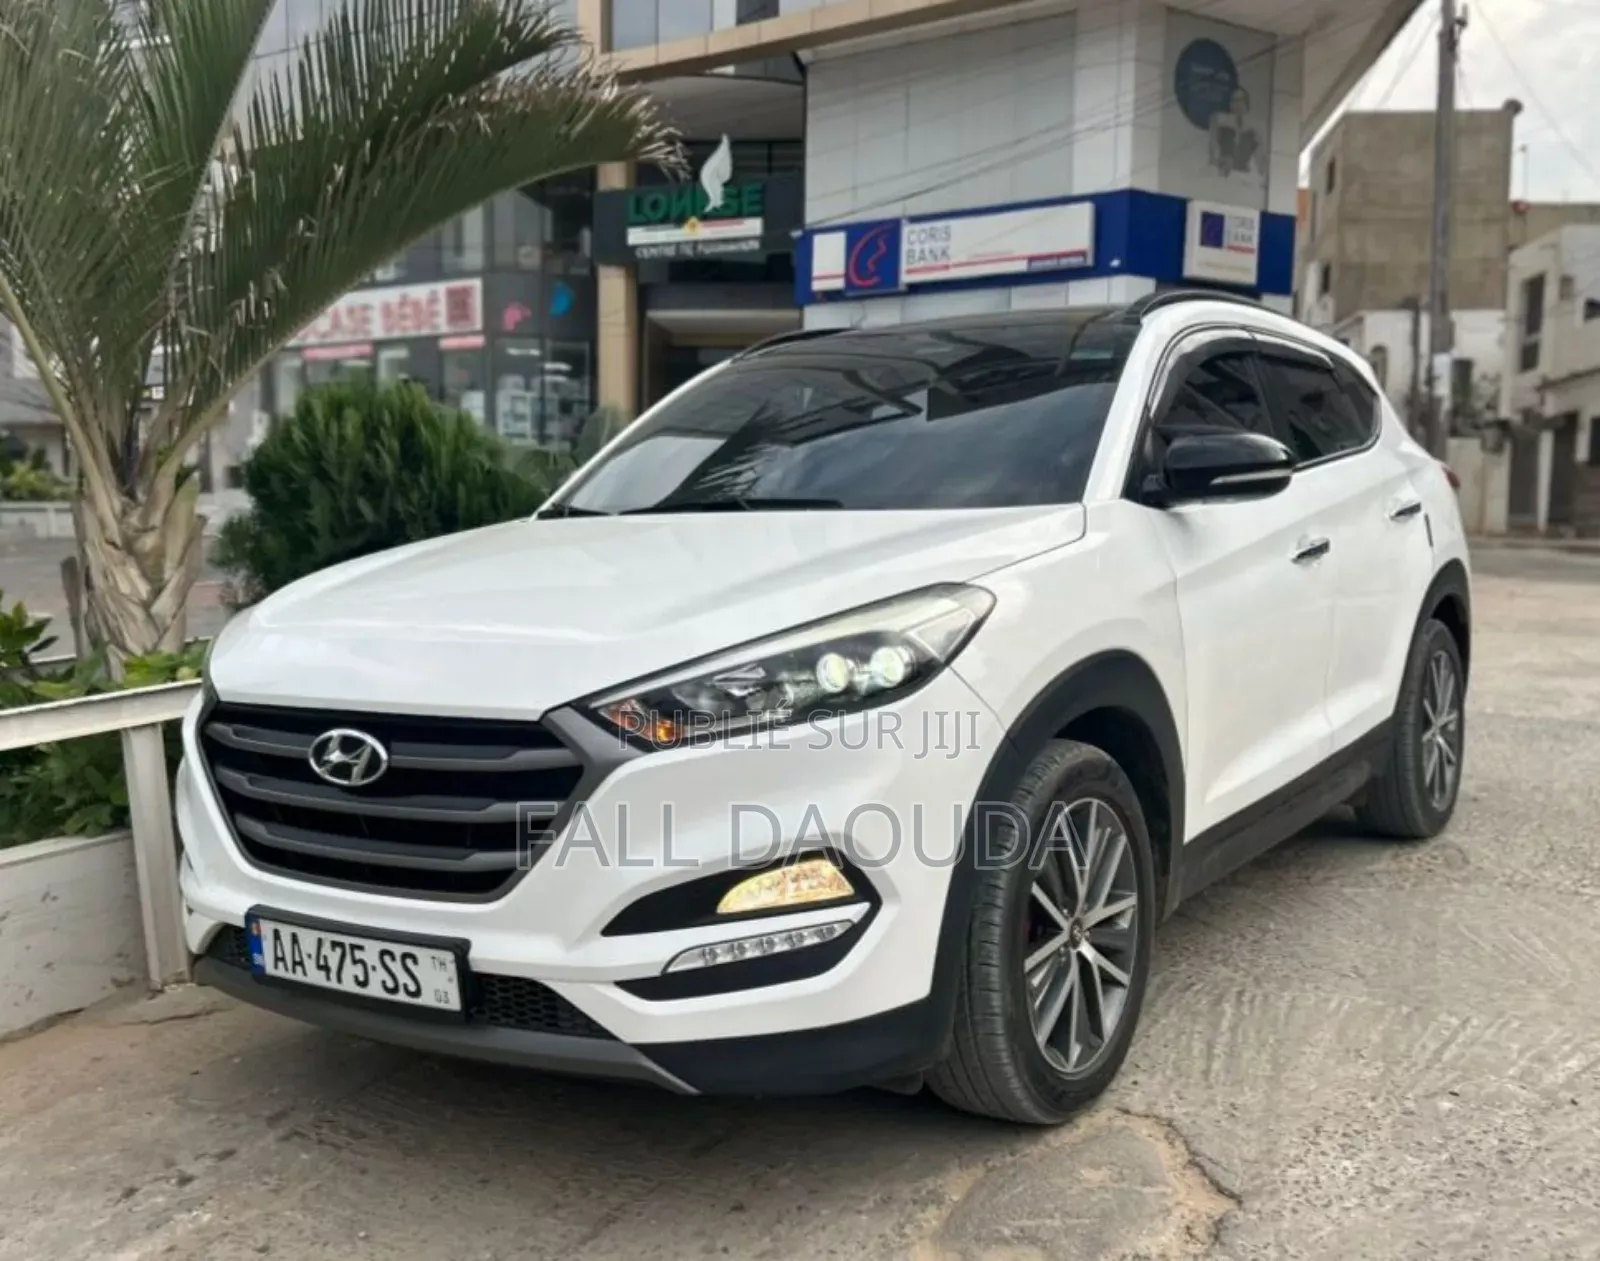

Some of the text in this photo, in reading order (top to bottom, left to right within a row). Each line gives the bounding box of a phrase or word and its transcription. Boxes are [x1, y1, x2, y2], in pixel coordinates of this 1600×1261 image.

[906, 225, 951, 245] CORIS
[906, 246, 950, 265] BANK
[431, 956, 448, 972] TH
